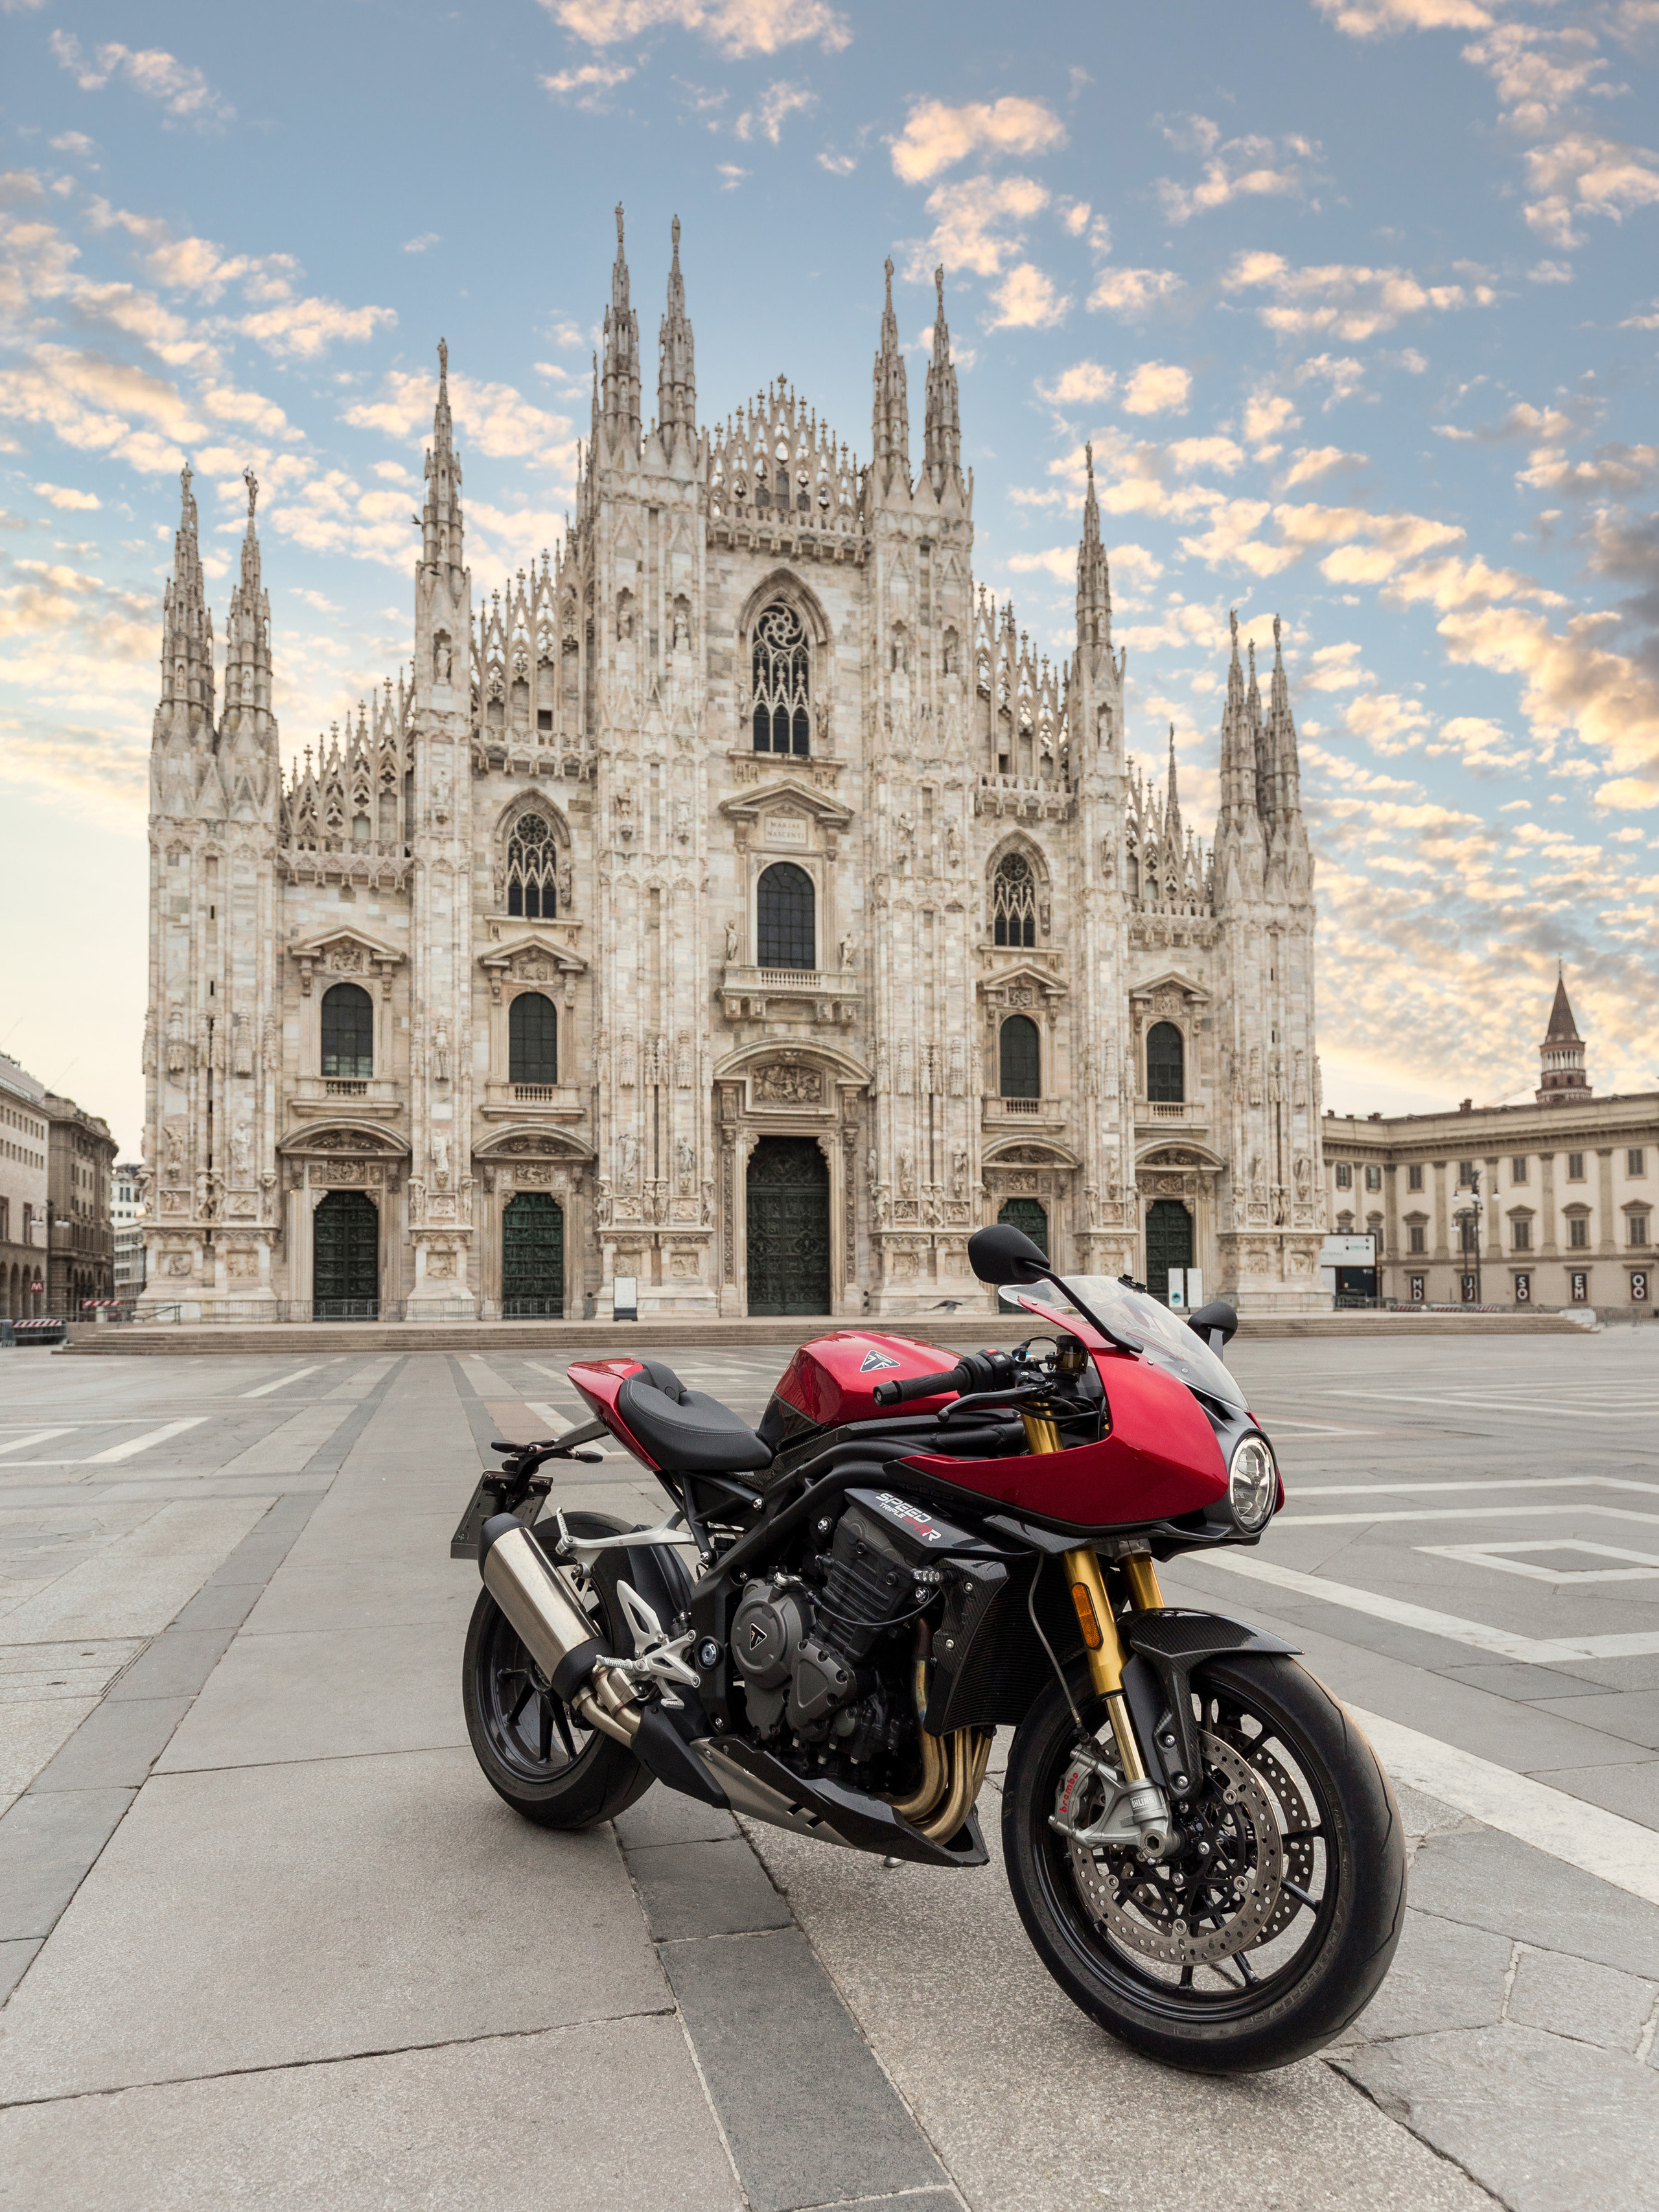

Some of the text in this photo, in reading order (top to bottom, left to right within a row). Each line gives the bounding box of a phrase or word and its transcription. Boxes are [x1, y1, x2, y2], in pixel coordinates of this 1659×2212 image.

[767, 830, 804, 839] NASCENTI
[1413, 1278, 1422, 1289] M
[1518, 1276, 1526, 1288] S
[1575, 1275, 1583, 1287] E
[1632, 1274, 1645, 1286] O
[1413, 1289, 1422, 1301] D
[1517, 1288, 1528, 1299] O
[1574, 1286, 1584, 1299] M
[1633, 1286, 1645, 1299] O
[876, 1493, 932, 1523] SPEED
[879, 1502, 907, 1519] TRIPLE
[913, 1524, 942, 1542] RR
[1060, 1773, 1078, 1813] brembo
[1131, 1796, 1155, 1808] ÖHLINS
